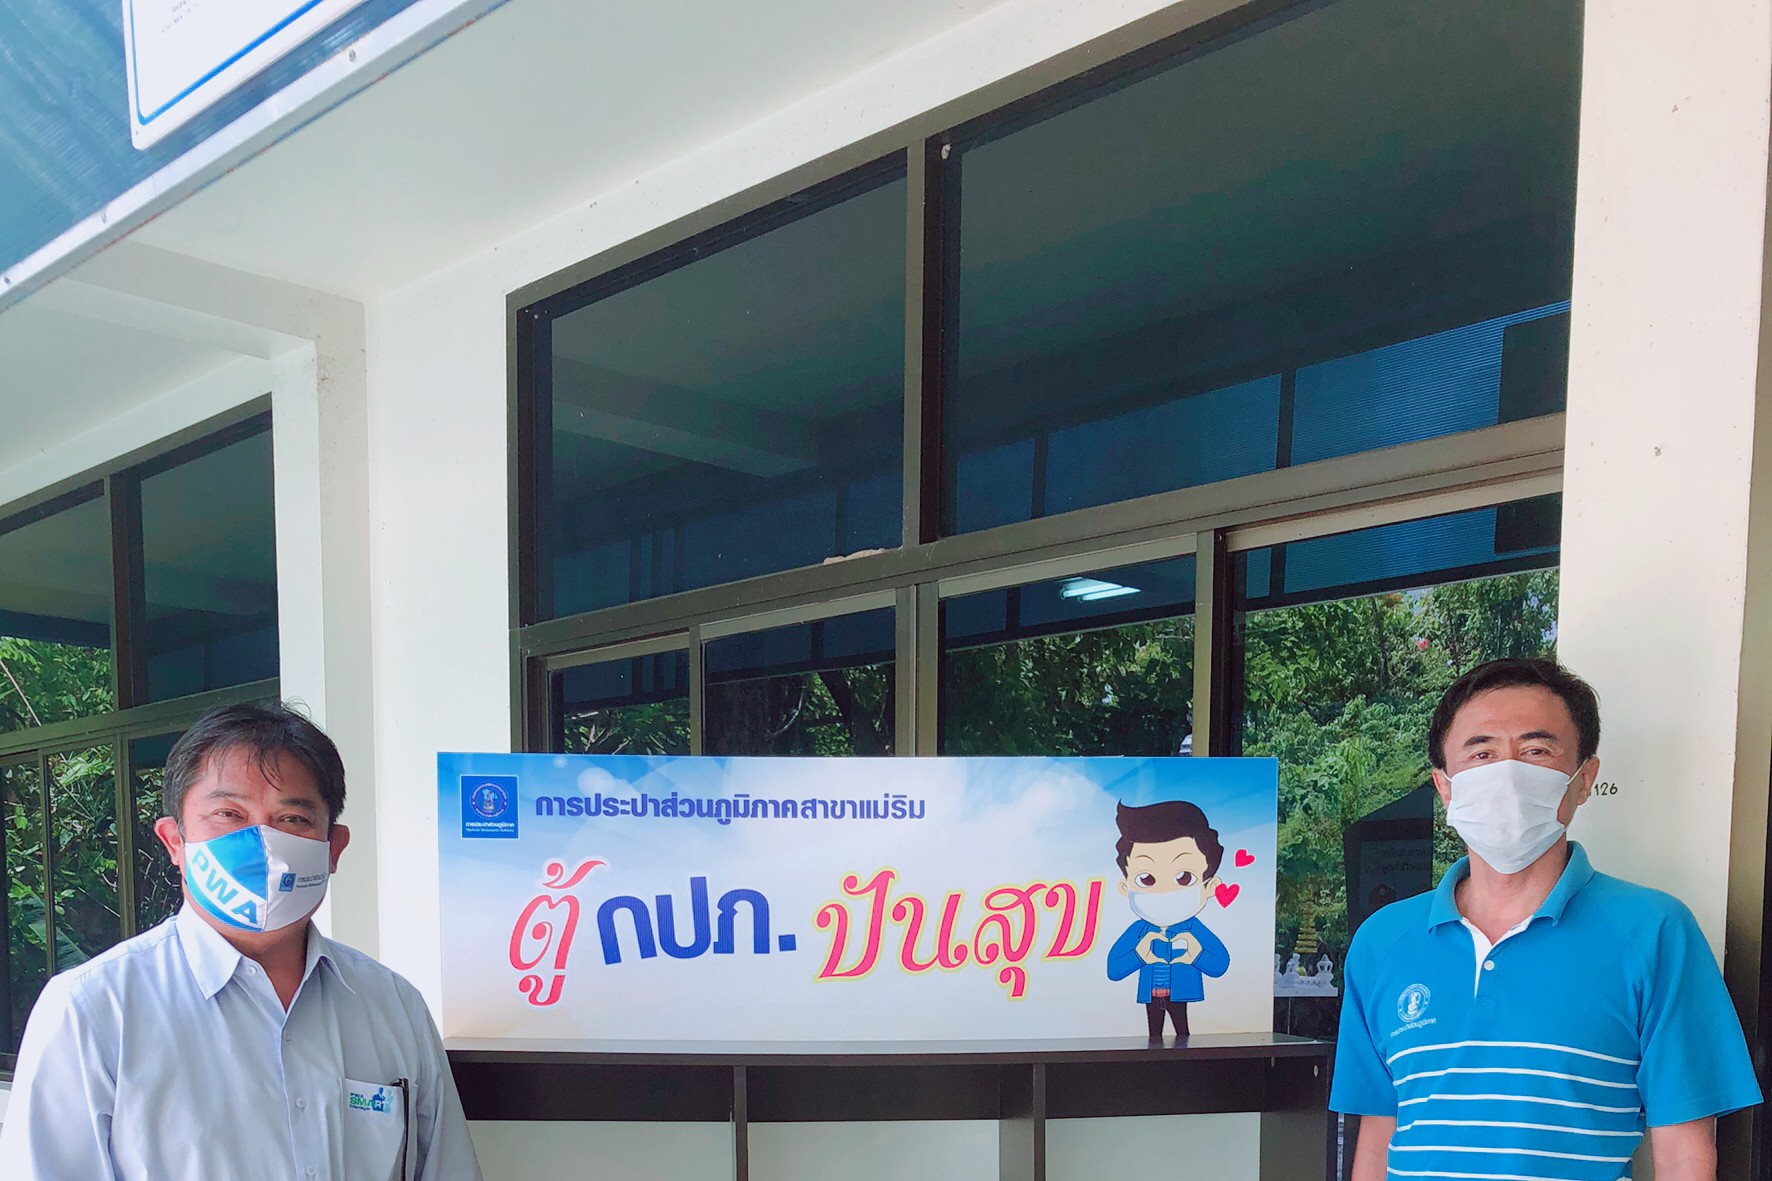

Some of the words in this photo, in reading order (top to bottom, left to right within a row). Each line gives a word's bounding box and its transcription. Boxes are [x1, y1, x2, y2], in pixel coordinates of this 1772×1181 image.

[1589, 782, 1618, 796] 126
[191, 849, 258, 925] PWA
[508, 859, 607, 1007] ตู้
[597, 876, 797, 966] กปภ.
[815, 869, 1103, 998] ปันสุข
